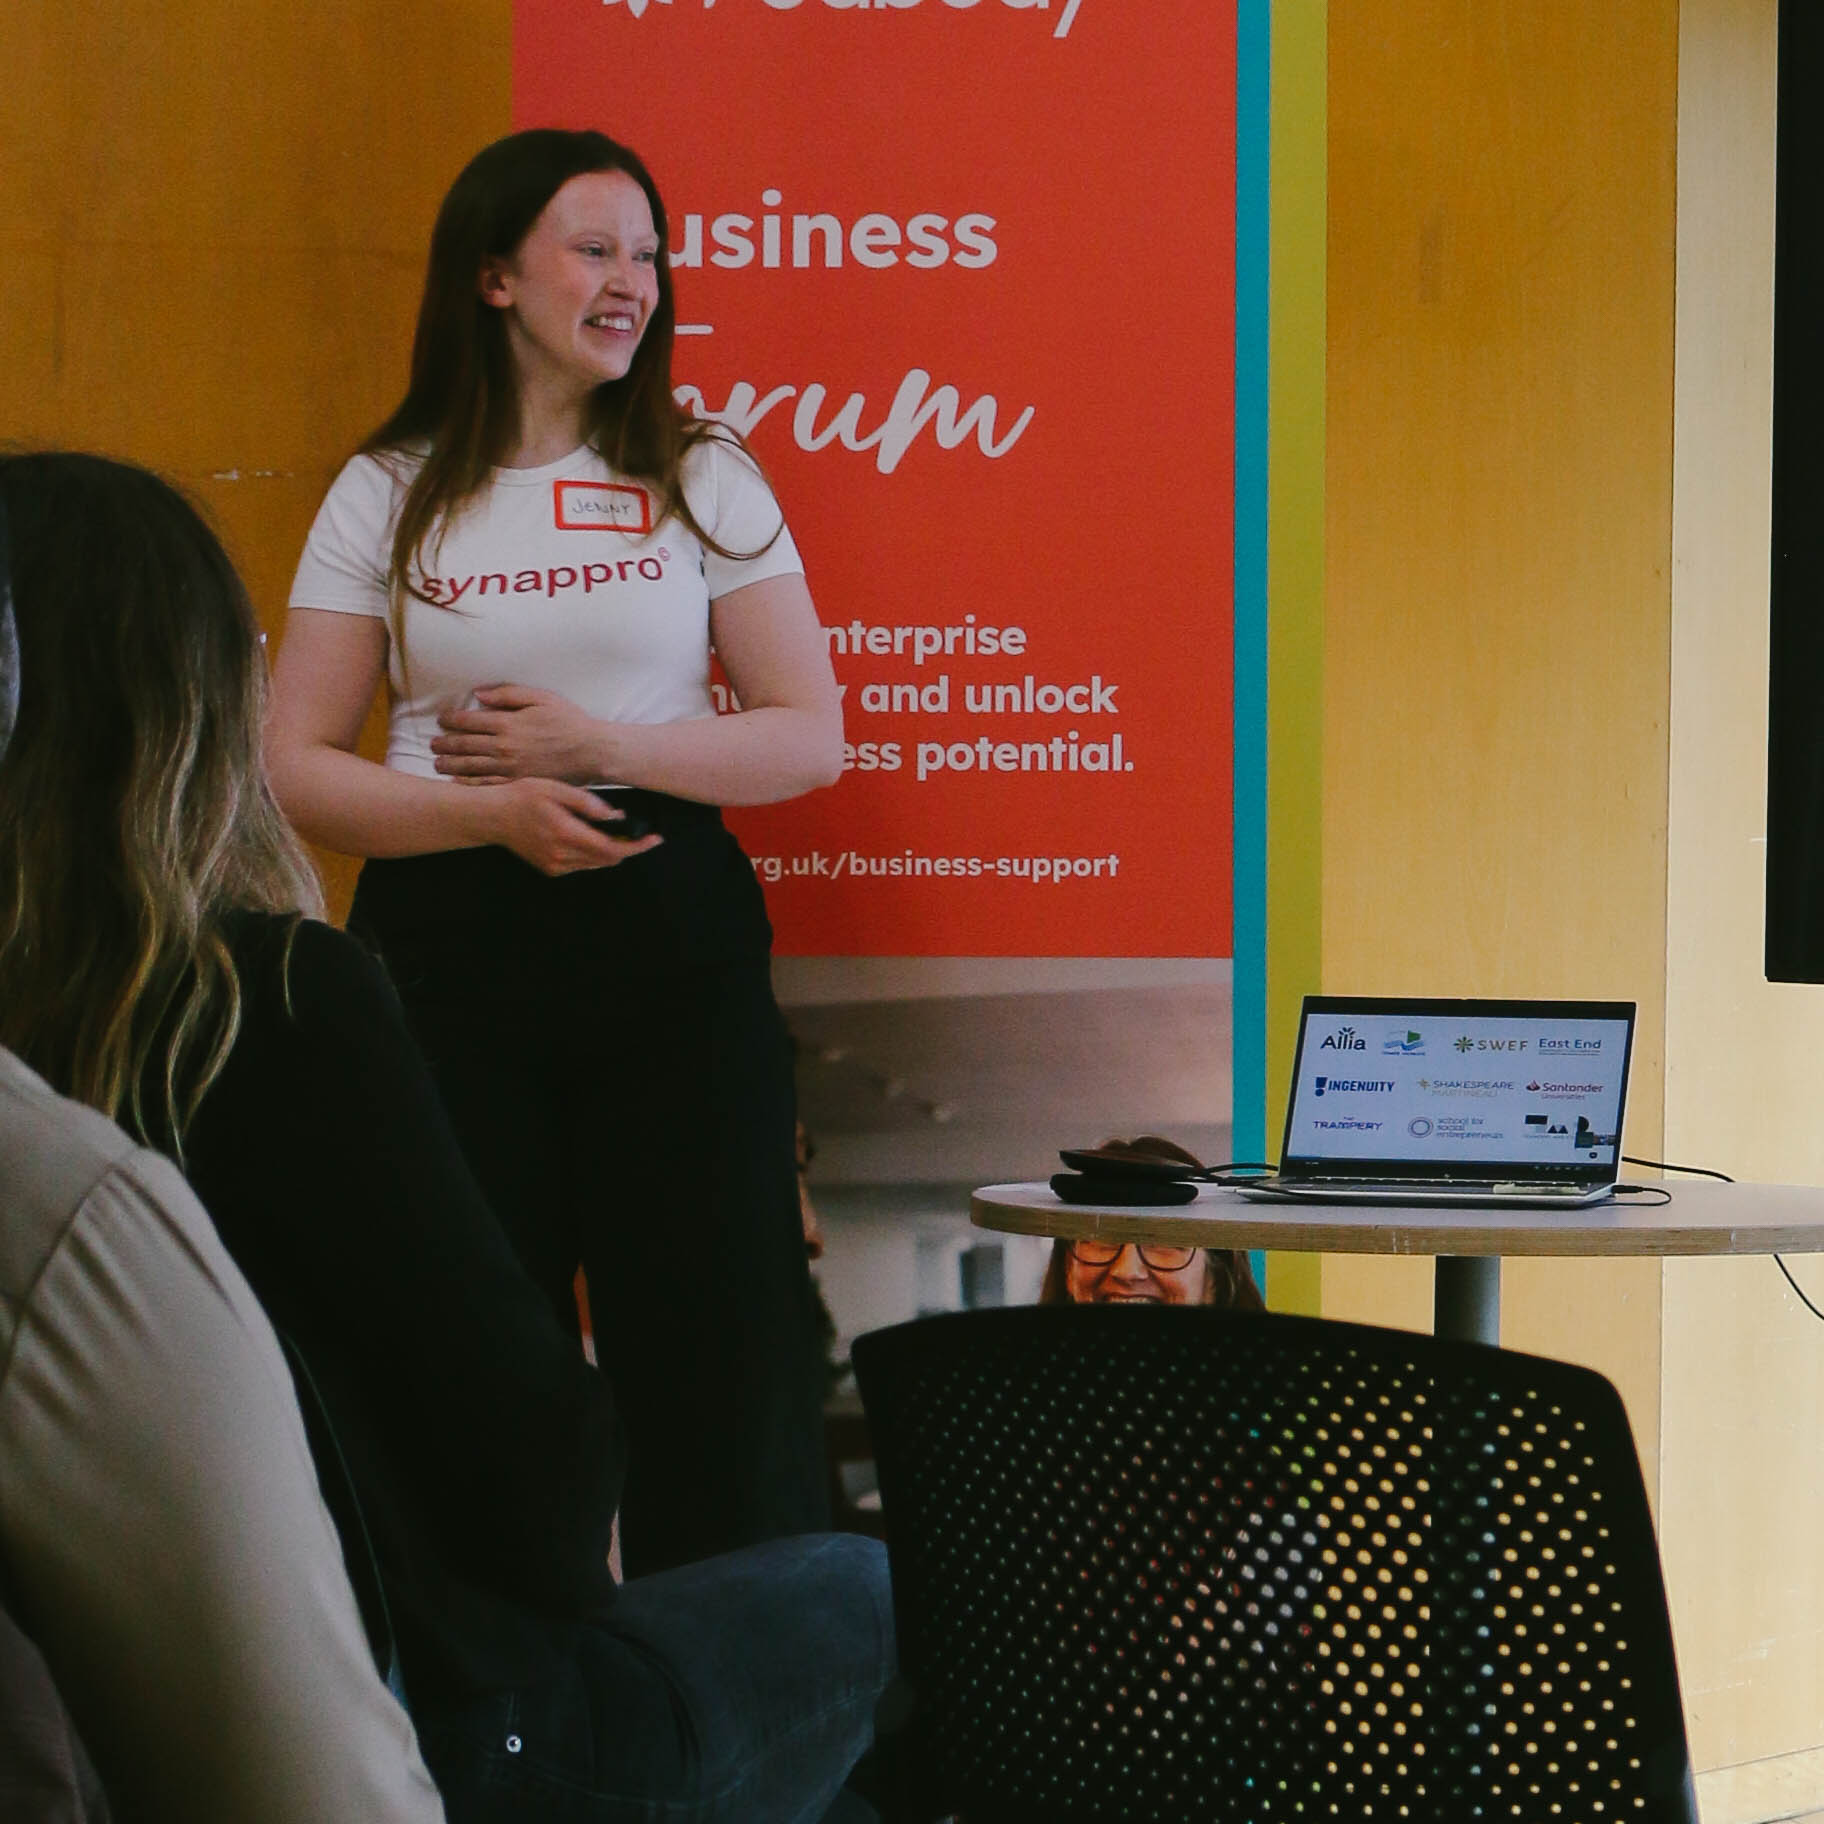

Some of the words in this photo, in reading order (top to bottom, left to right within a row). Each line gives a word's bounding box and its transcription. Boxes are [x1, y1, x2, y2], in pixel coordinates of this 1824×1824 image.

[670, 188, 999, 269] usiness
[822, 614, 1028, 665] nterprise
[860, 674, 950, 714] and
[964, 675, 1119, 714] unlock
[915, 730, 1136, 782] potential.
[1477, 1040, 1528, 1051] SWEF
[1539, 1038, 1569, 1049] East
[1574, 1039, 1602, 1049] End
[1328, 1080, 1395, 1093] INGENUITY
